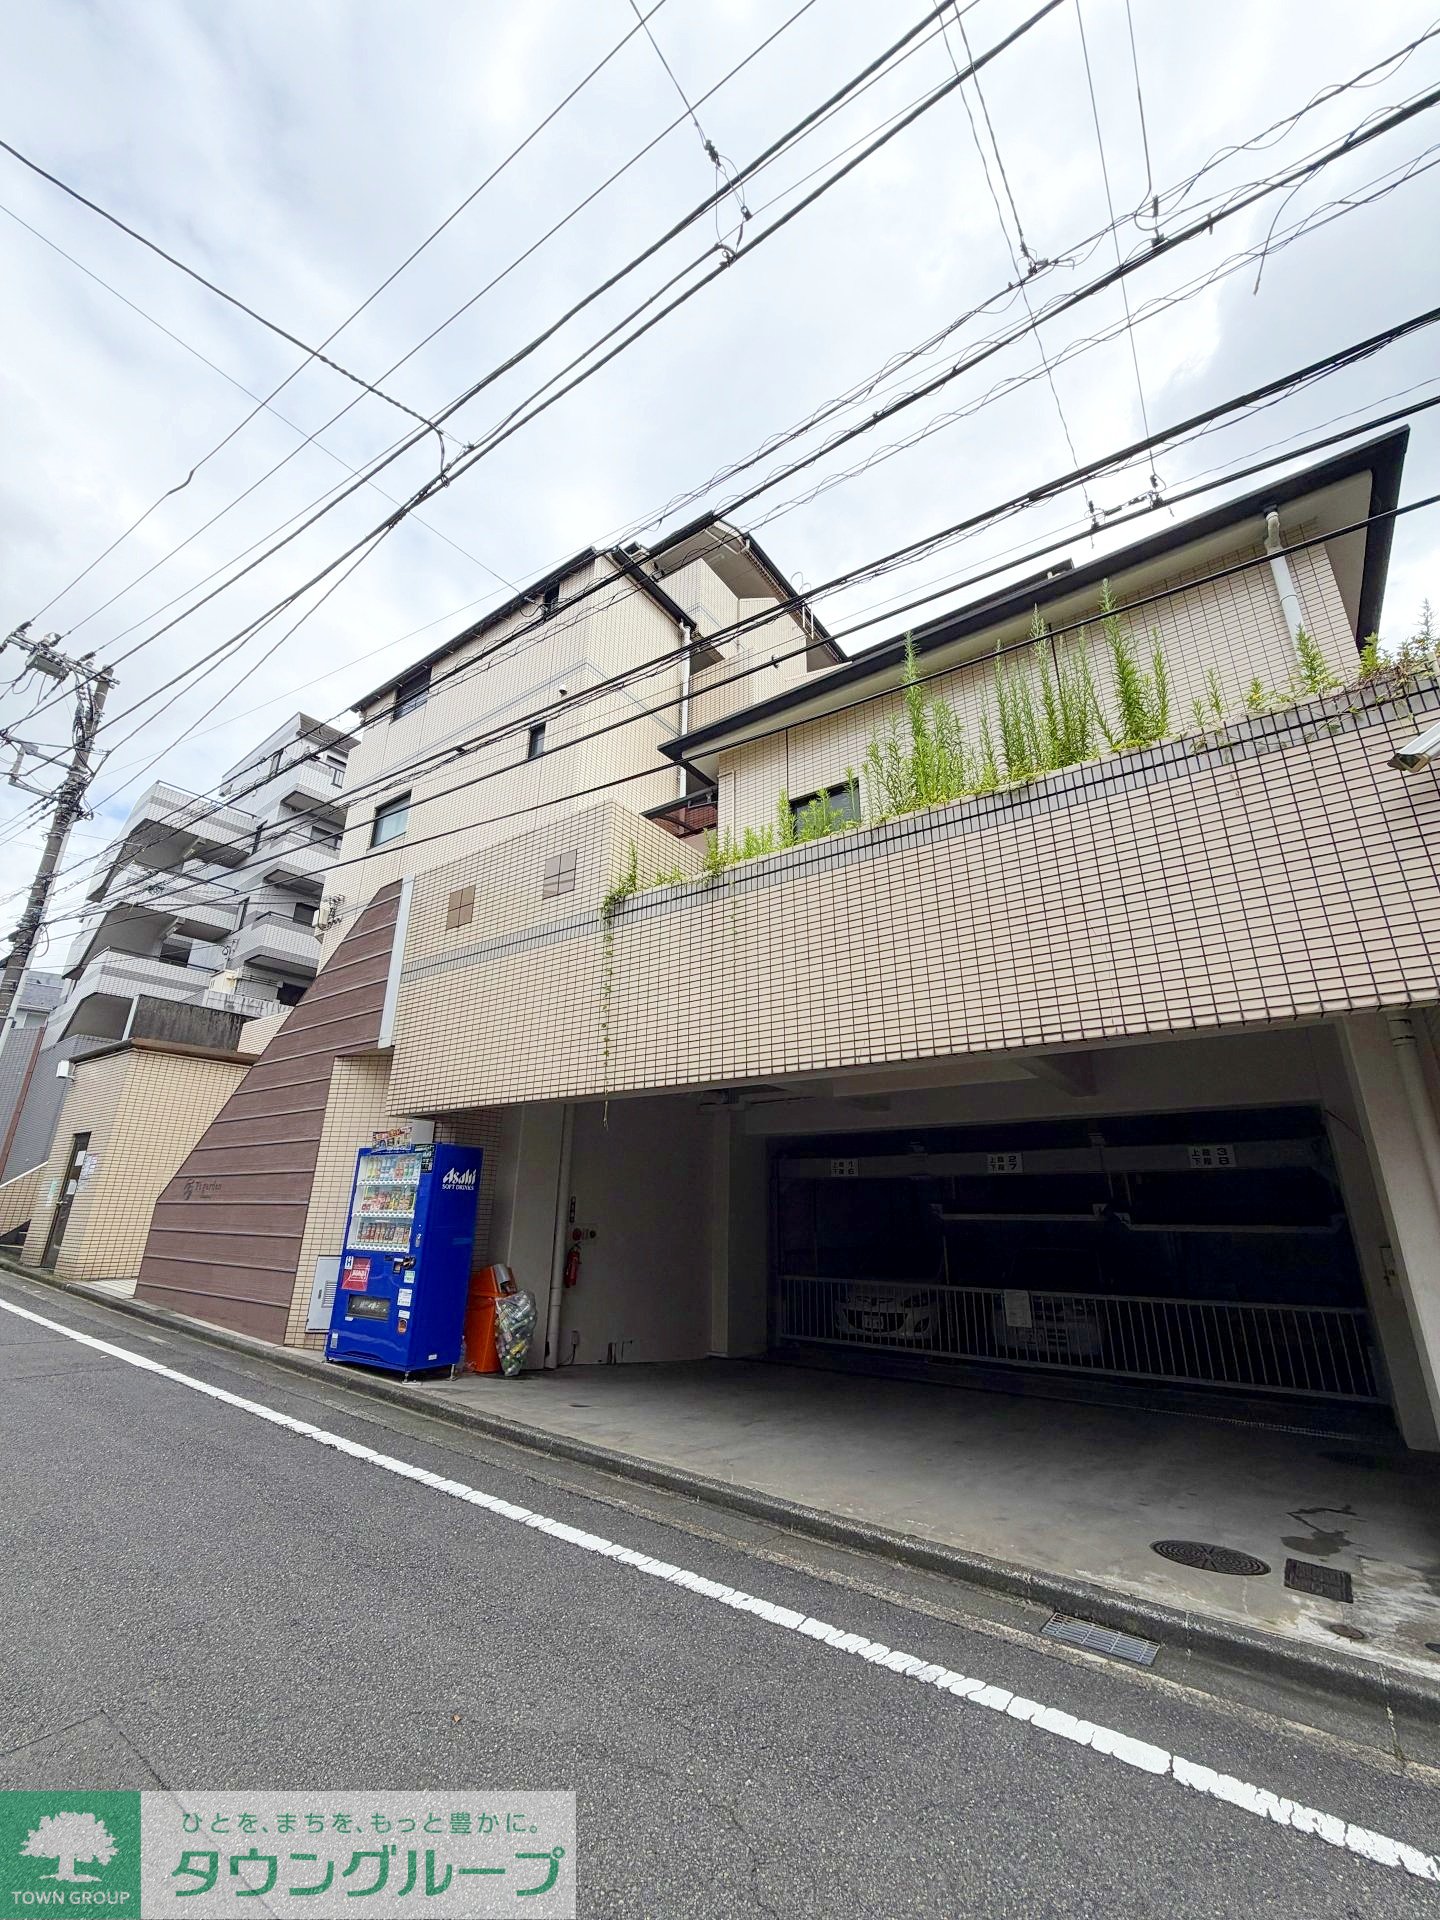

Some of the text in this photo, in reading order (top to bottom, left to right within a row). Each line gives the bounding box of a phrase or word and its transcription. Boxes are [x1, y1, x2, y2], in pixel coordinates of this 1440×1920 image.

[1216, 1147, 1228, 1156] 3
[1008, 1155, 1017, 1163] 2
[442, 1167, 477, 1185] Asahi
